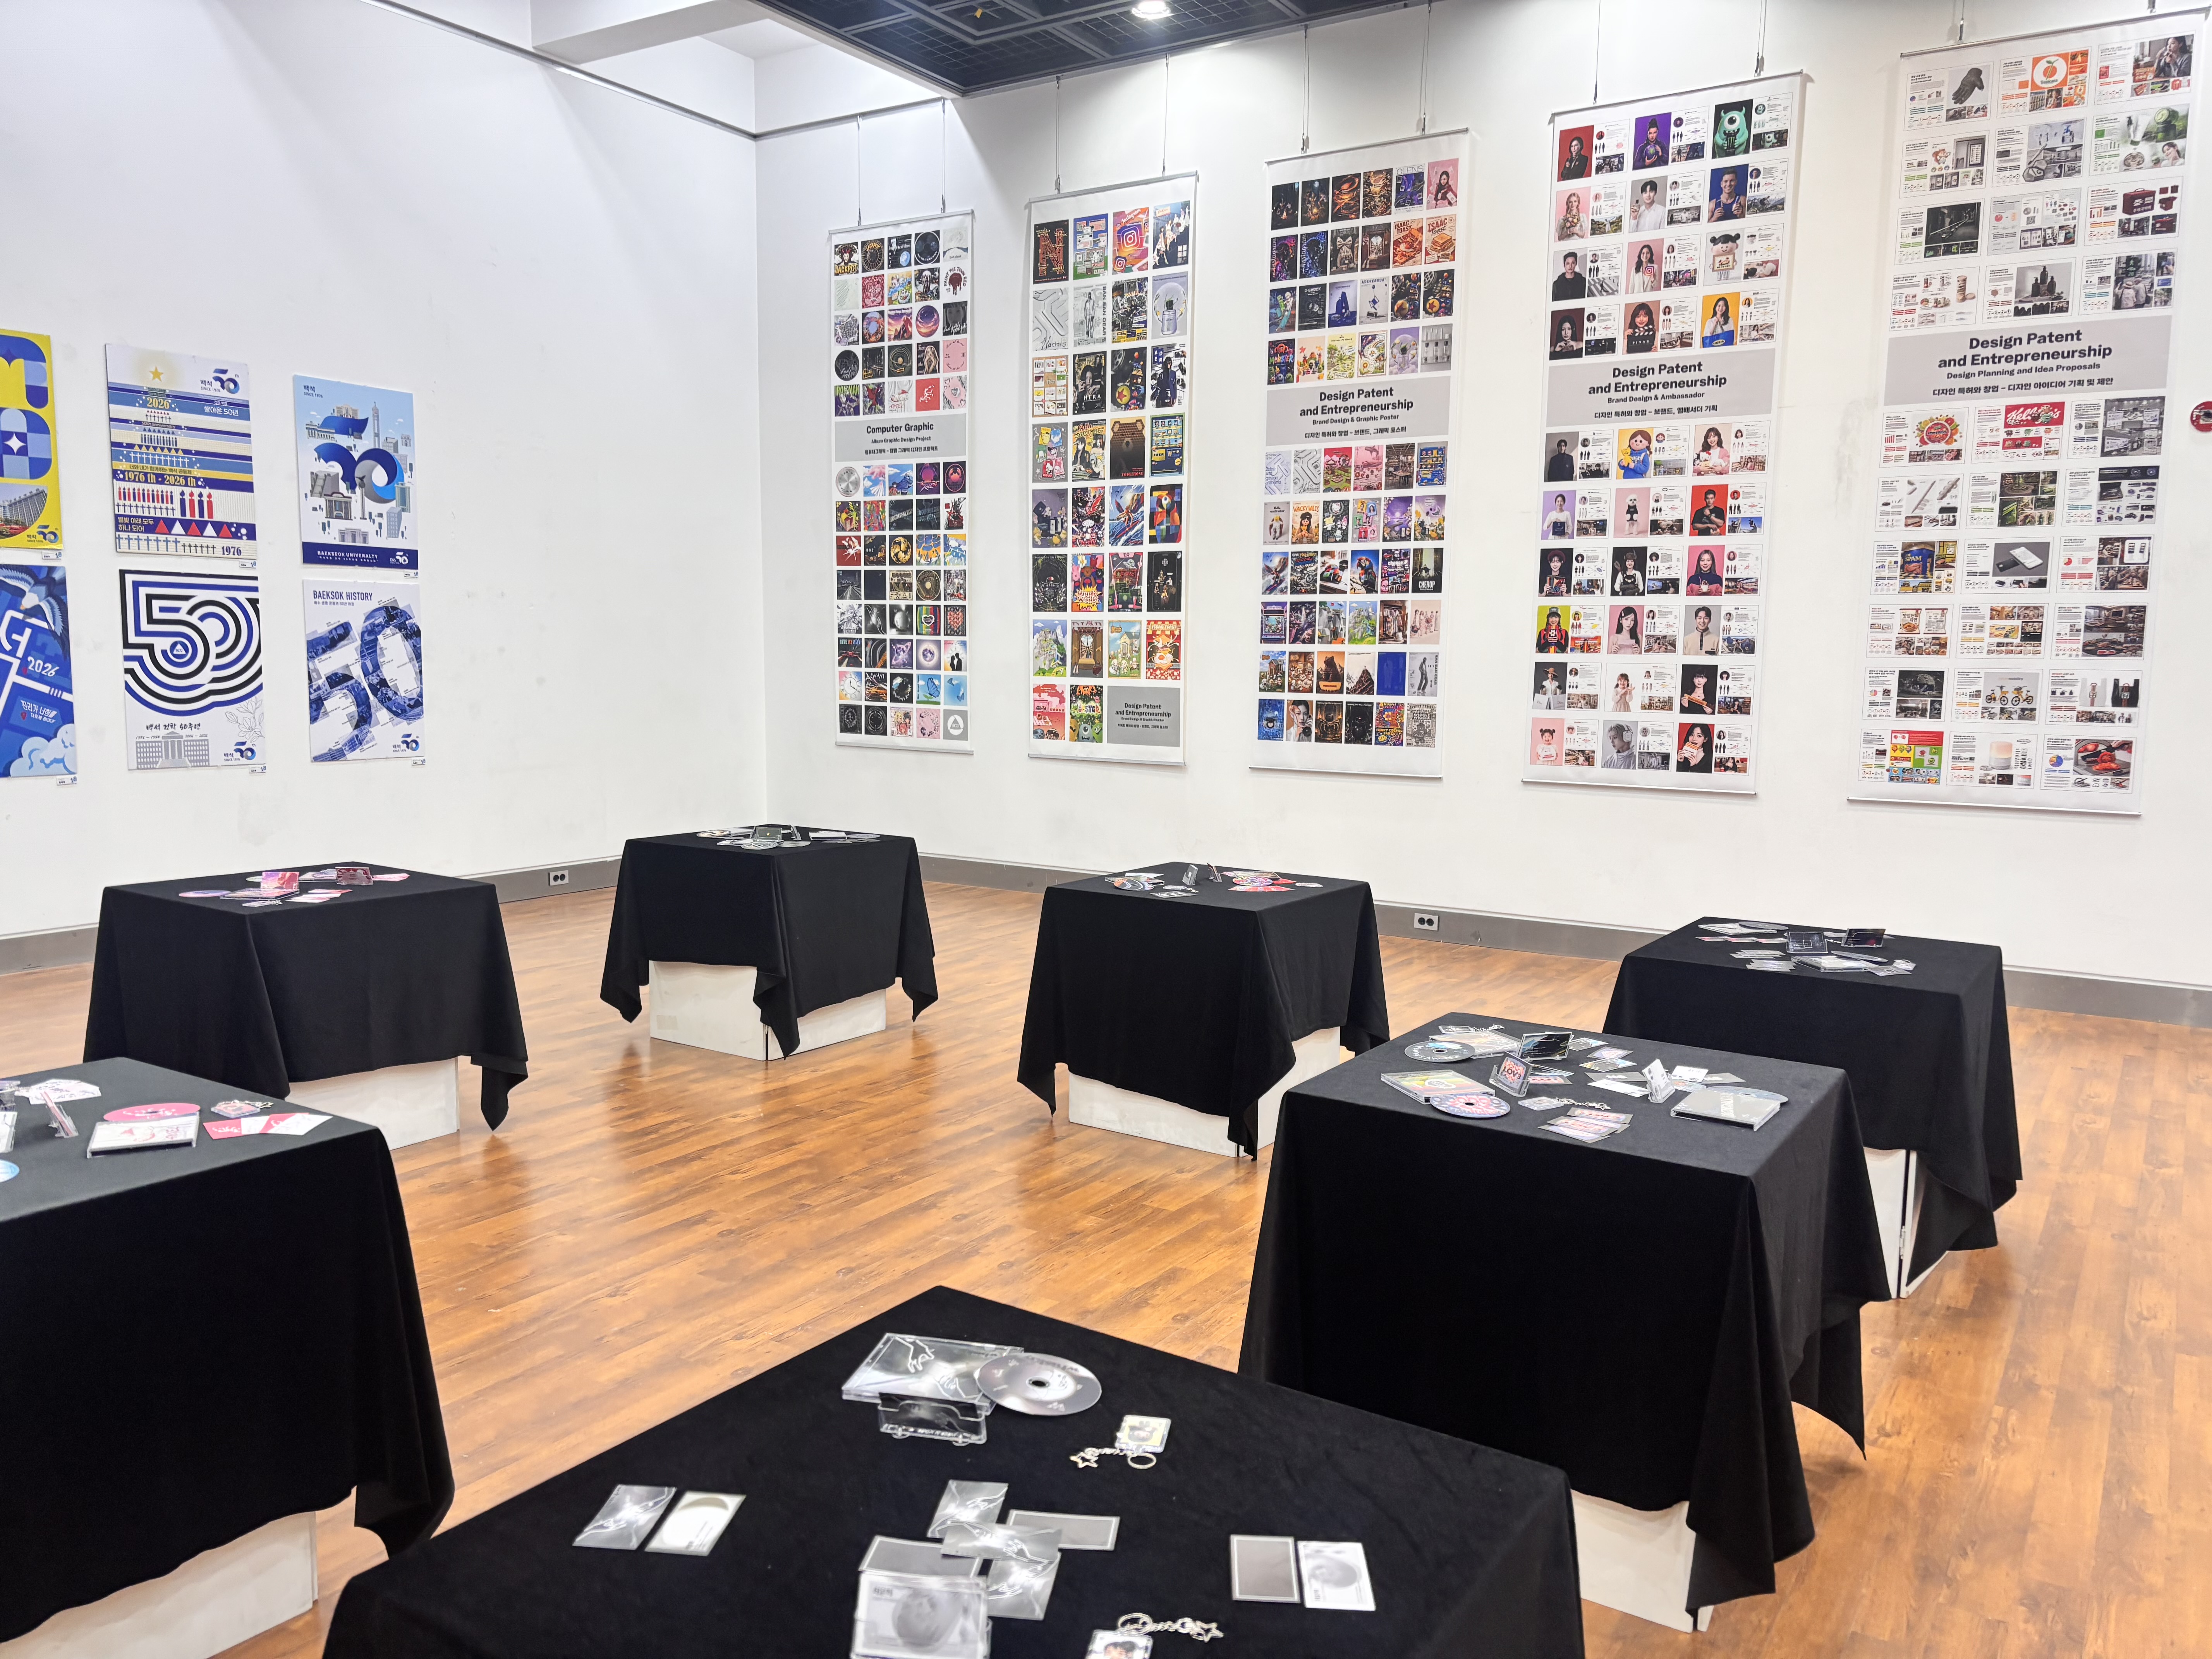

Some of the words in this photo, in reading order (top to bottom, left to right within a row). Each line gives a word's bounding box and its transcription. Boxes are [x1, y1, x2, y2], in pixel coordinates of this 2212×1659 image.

[1395, 220, 1409, 230] ISAAC
[1396, 225, 1412, 234] TOAST
[1427, 218, 1448, 232] ISAAC
[835, 263, 858, 275] JACKPOT
[1969, 335, 2022, 350] Design
[2027, 329, 2082, 346] Patent
[1938, 354, 1966, 368] and
[1971, 344, 2112, 366] Entrepreneurship
[1612, 366, 1655, 379] Design
[1658, 361, 1703, 374] Patent
[1947, 370, 1976, 379] Design
[1978, 368, 2015, 378] Planning
[2017, 366, 2032, 374] and
[2035, 364, 2053, 372] Idea
[2056, 362, 2100, 373] Proposals
[1588, 383, 1611, 395] and
[1614, 374, 1727, 393] Entrepreneurship
[1932, 387, 1956, 396] 디자인
[2008, 383, 2032, 392] 디자인
[2033, 381, 2066, 390] 아이디어
[2069, 379, 2084, 387] 기획
[2097, 377, 2114, 386] 제안
[1319, 390, 1355, 402] Design
[1357, 387, 1394, 398] Patent
[1629, 395, 1652, 403] Design
[1661, 391, 1705, 400] Ambassador
[147, 397, 170, 409] 2026
[1300, 405, 1318, 417] and
[1321, 399, 1413, 416] Entrepreneurship
[866, 424, 903, 434] Computer
[905, 421, 934, 433] Graphic
[124, 471, 145, 482] 1976
[148, 473, 156, 483] th
[164, 475, 185, 486] 2026
[188, 477, 196, 486] th
[222, 545, 242, 556] 1976
[313, 590, 344, 601] BAEKSOK
[346, 592, 373, 601] HISTORY
[27, 656, 60, 677] 2026
[146, 723, 161, 731] 백석
